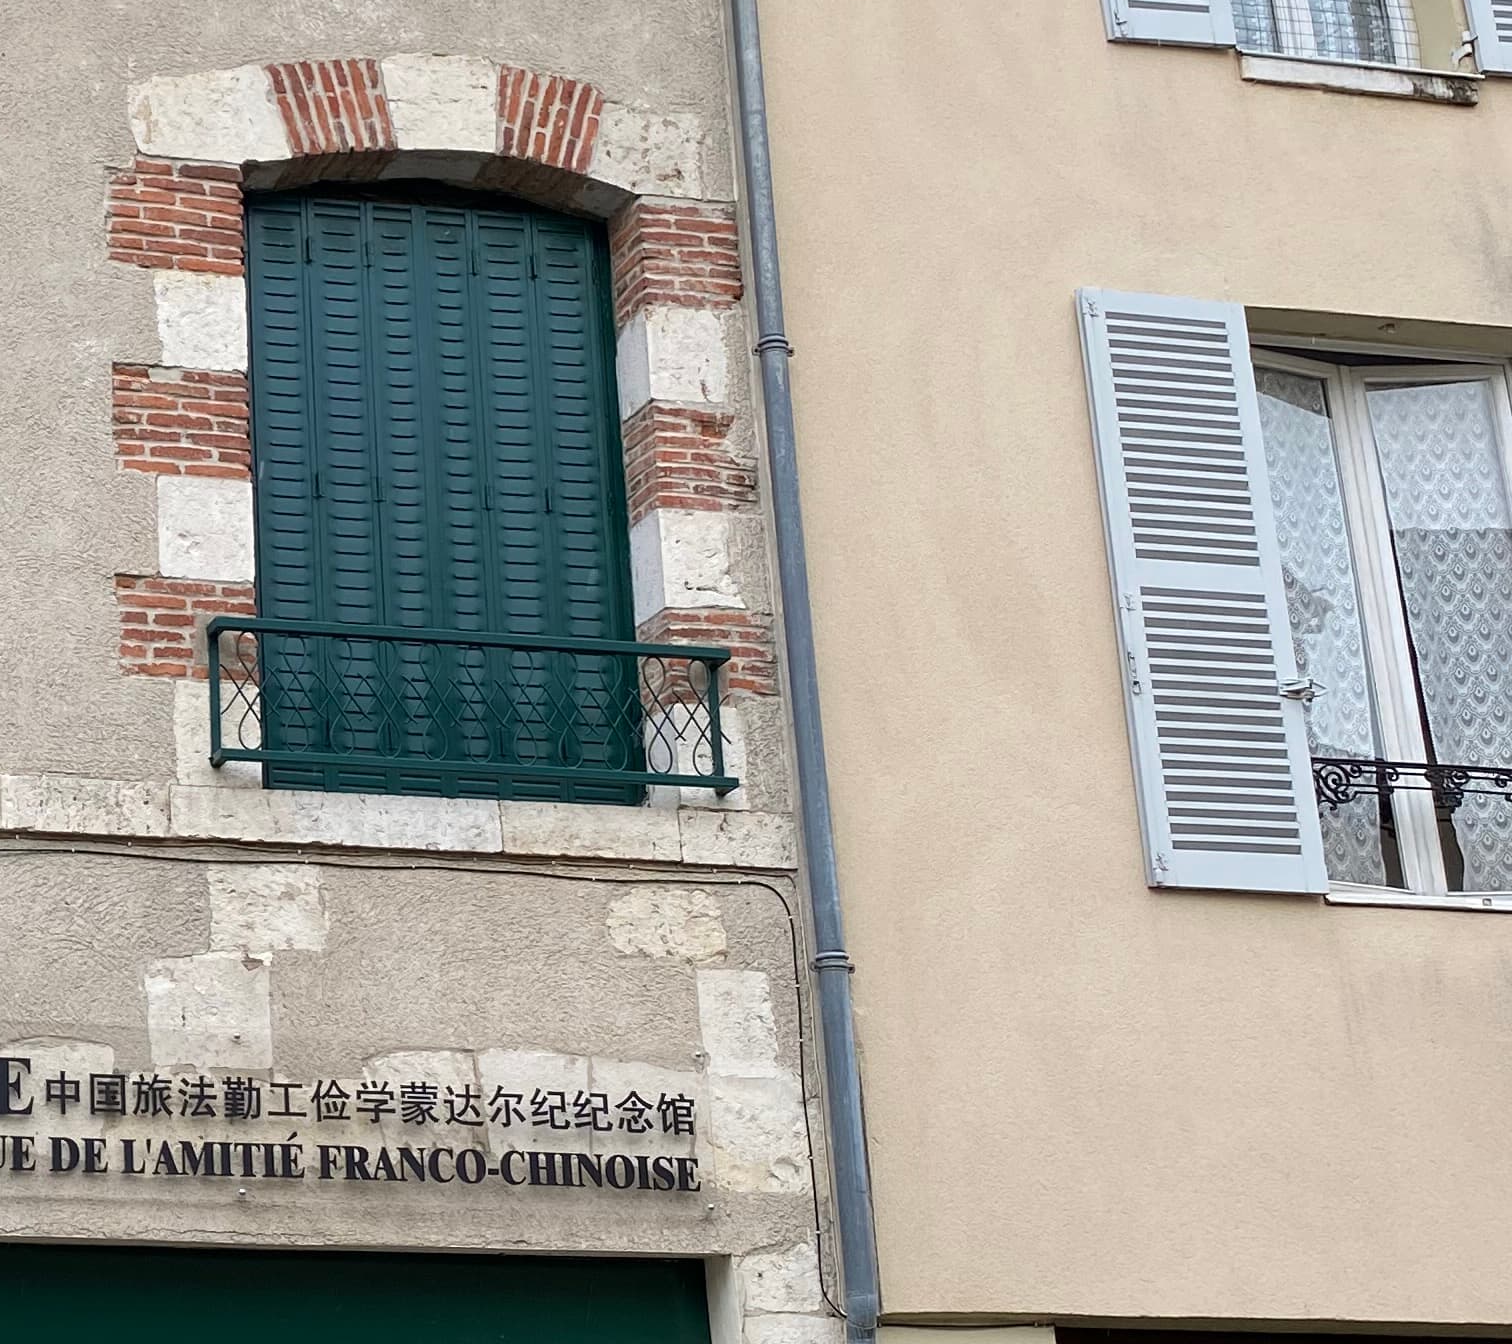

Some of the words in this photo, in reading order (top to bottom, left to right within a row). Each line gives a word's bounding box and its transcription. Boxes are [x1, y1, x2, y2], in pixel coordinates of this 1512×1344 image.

[45, 1069, 696, 1137] 中国旅法勤工俭学蒙达尔纪纪念馆
[48, 1136, 108, 1174] DE
[120, 1131, 305, 1178] L'AMITIÉ
[317, 1143, 702, 1193] FRANCO-CHINOISE
